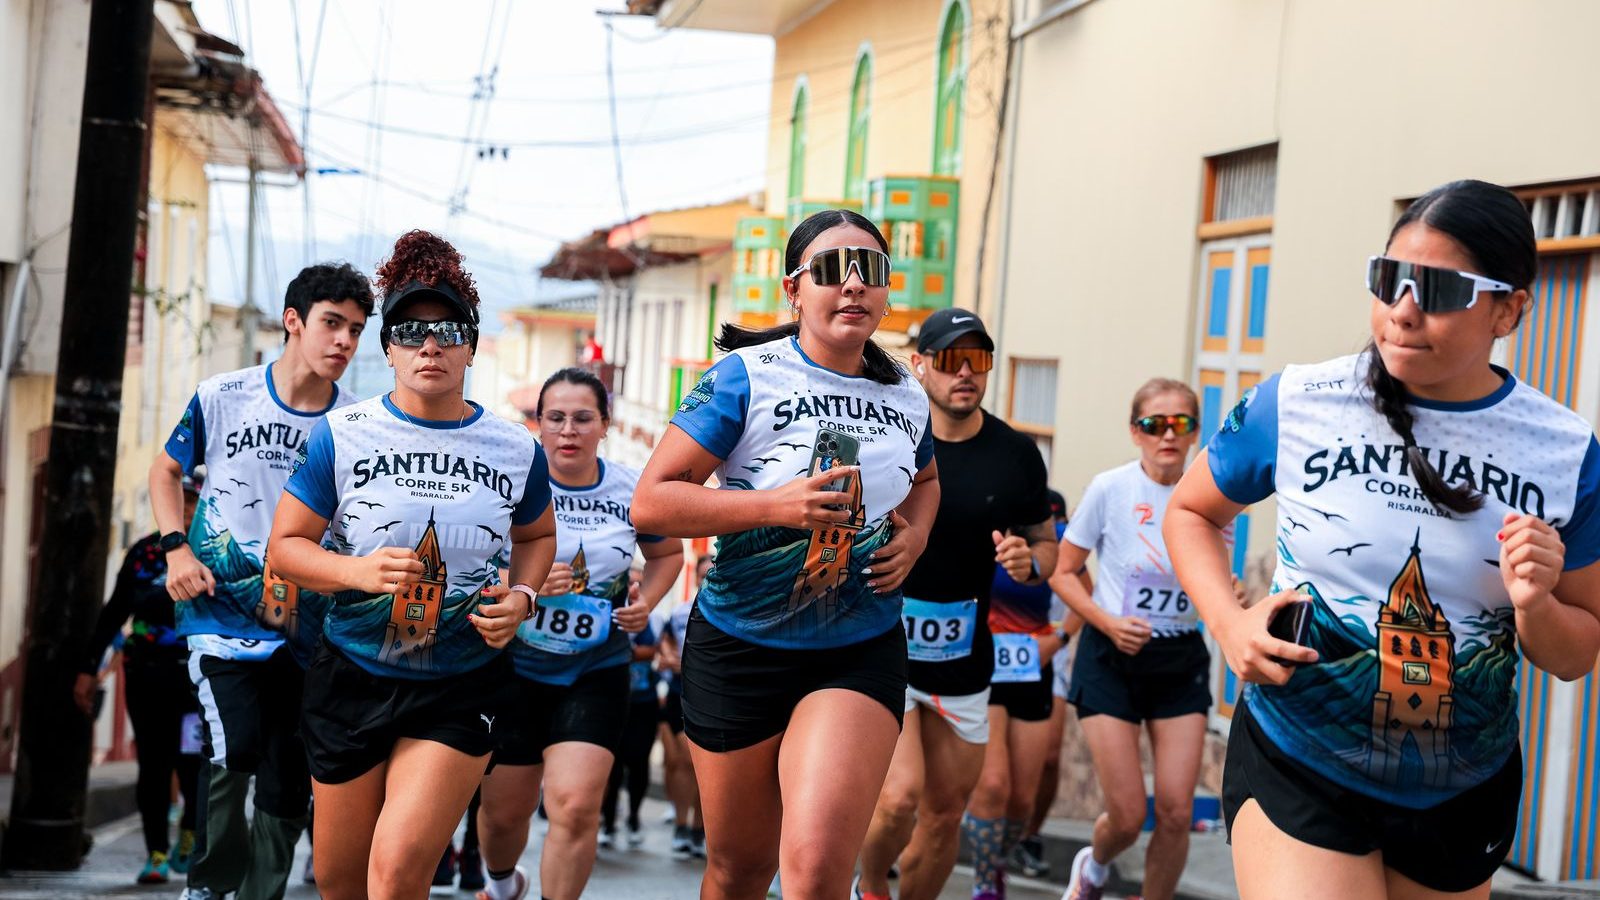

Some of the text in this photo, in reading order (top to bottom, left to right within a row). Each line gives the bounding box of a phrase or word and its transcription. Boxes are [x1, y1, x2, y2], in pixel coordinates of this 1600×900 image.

[760, 353, 785, 364] 2FI
[220, 381, 244, 391] 2FIT
[1304, 379, 1344, 391] 2FIT
[345, 412, 372, 422] 2FI
[773, 393, 918, 446] SANTUARIO
[818, 419, 888, 436] CORRE 5K
[226, 422, 303, 459] SANTU
[353, 451, 513, 502] SANTUARIO
[394, 477, 471, 494] CORRE 5K
[410, 491, 455, 501] RISARALDA
[1365, 478, 1425, 501] CORR
[553, 495, 635, 527] NTUARI
[557, 513, 608, 525] CORRE 5K
[1387, 501, 1453, 519] RISARALDA
[1136, 587, 1189, 612] 276
[535, 606, 594, 639] 188
[905, 616, 961, 642] 103
